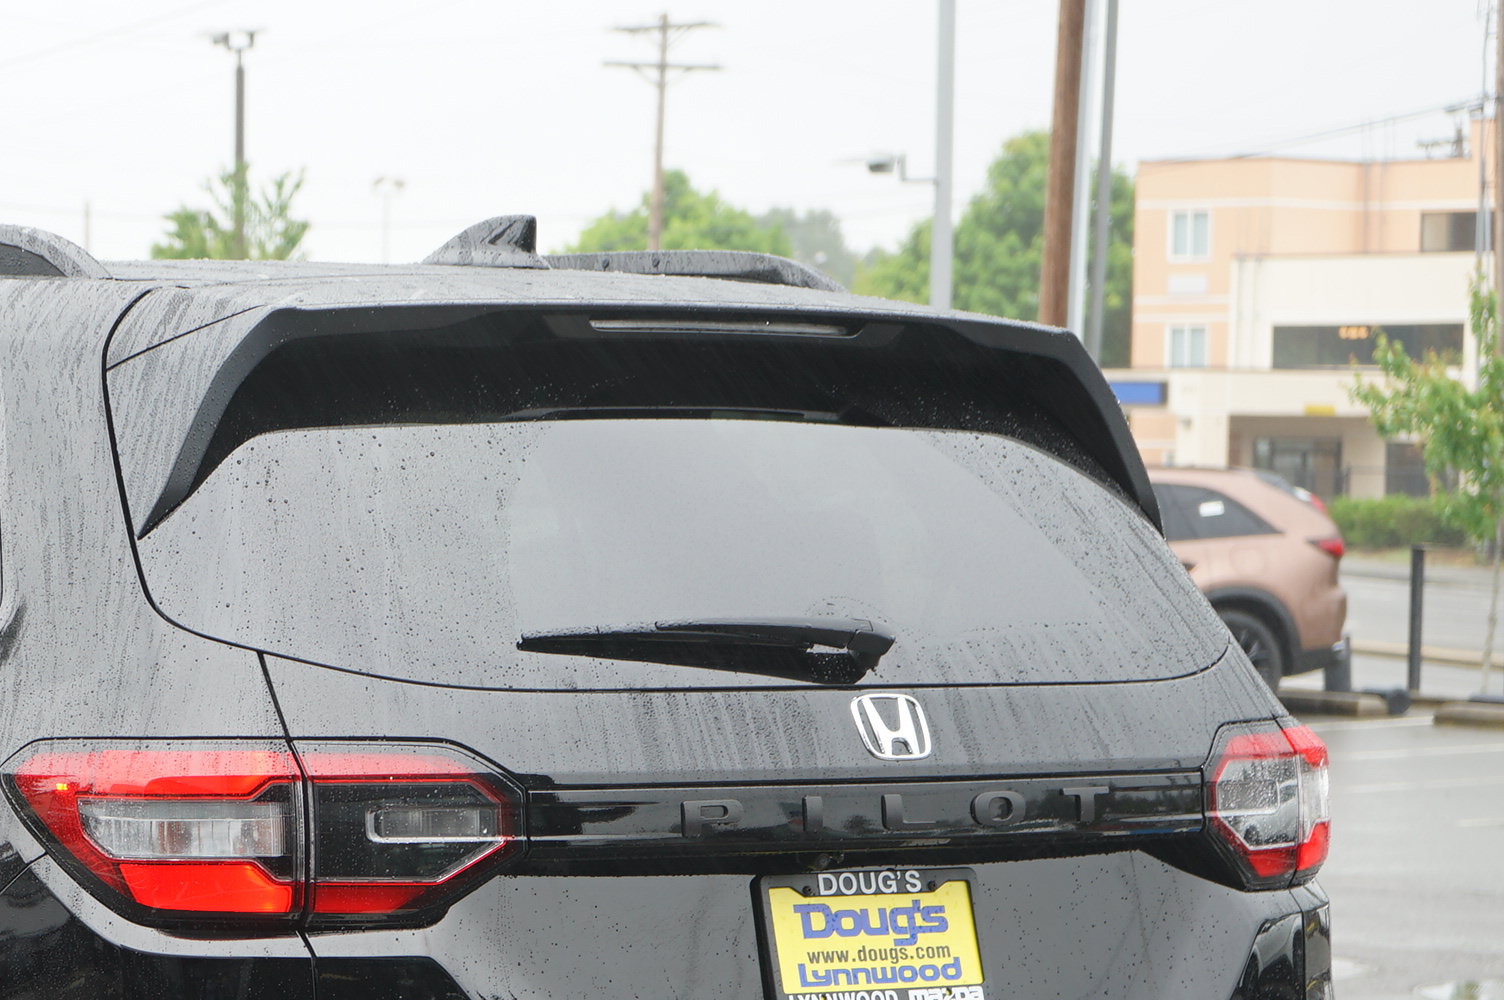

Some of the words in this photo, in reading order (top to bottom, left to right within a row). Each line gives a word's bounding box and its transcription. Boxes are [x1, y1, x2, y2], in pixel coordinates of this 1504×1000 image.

[680, 784, 1110, 838] PILOT
[817, 870, 922, 896] DOUG'S
[807, 945, 952, 965] www.dougs.com
[797, 956, 963, 988] Lynnwood
